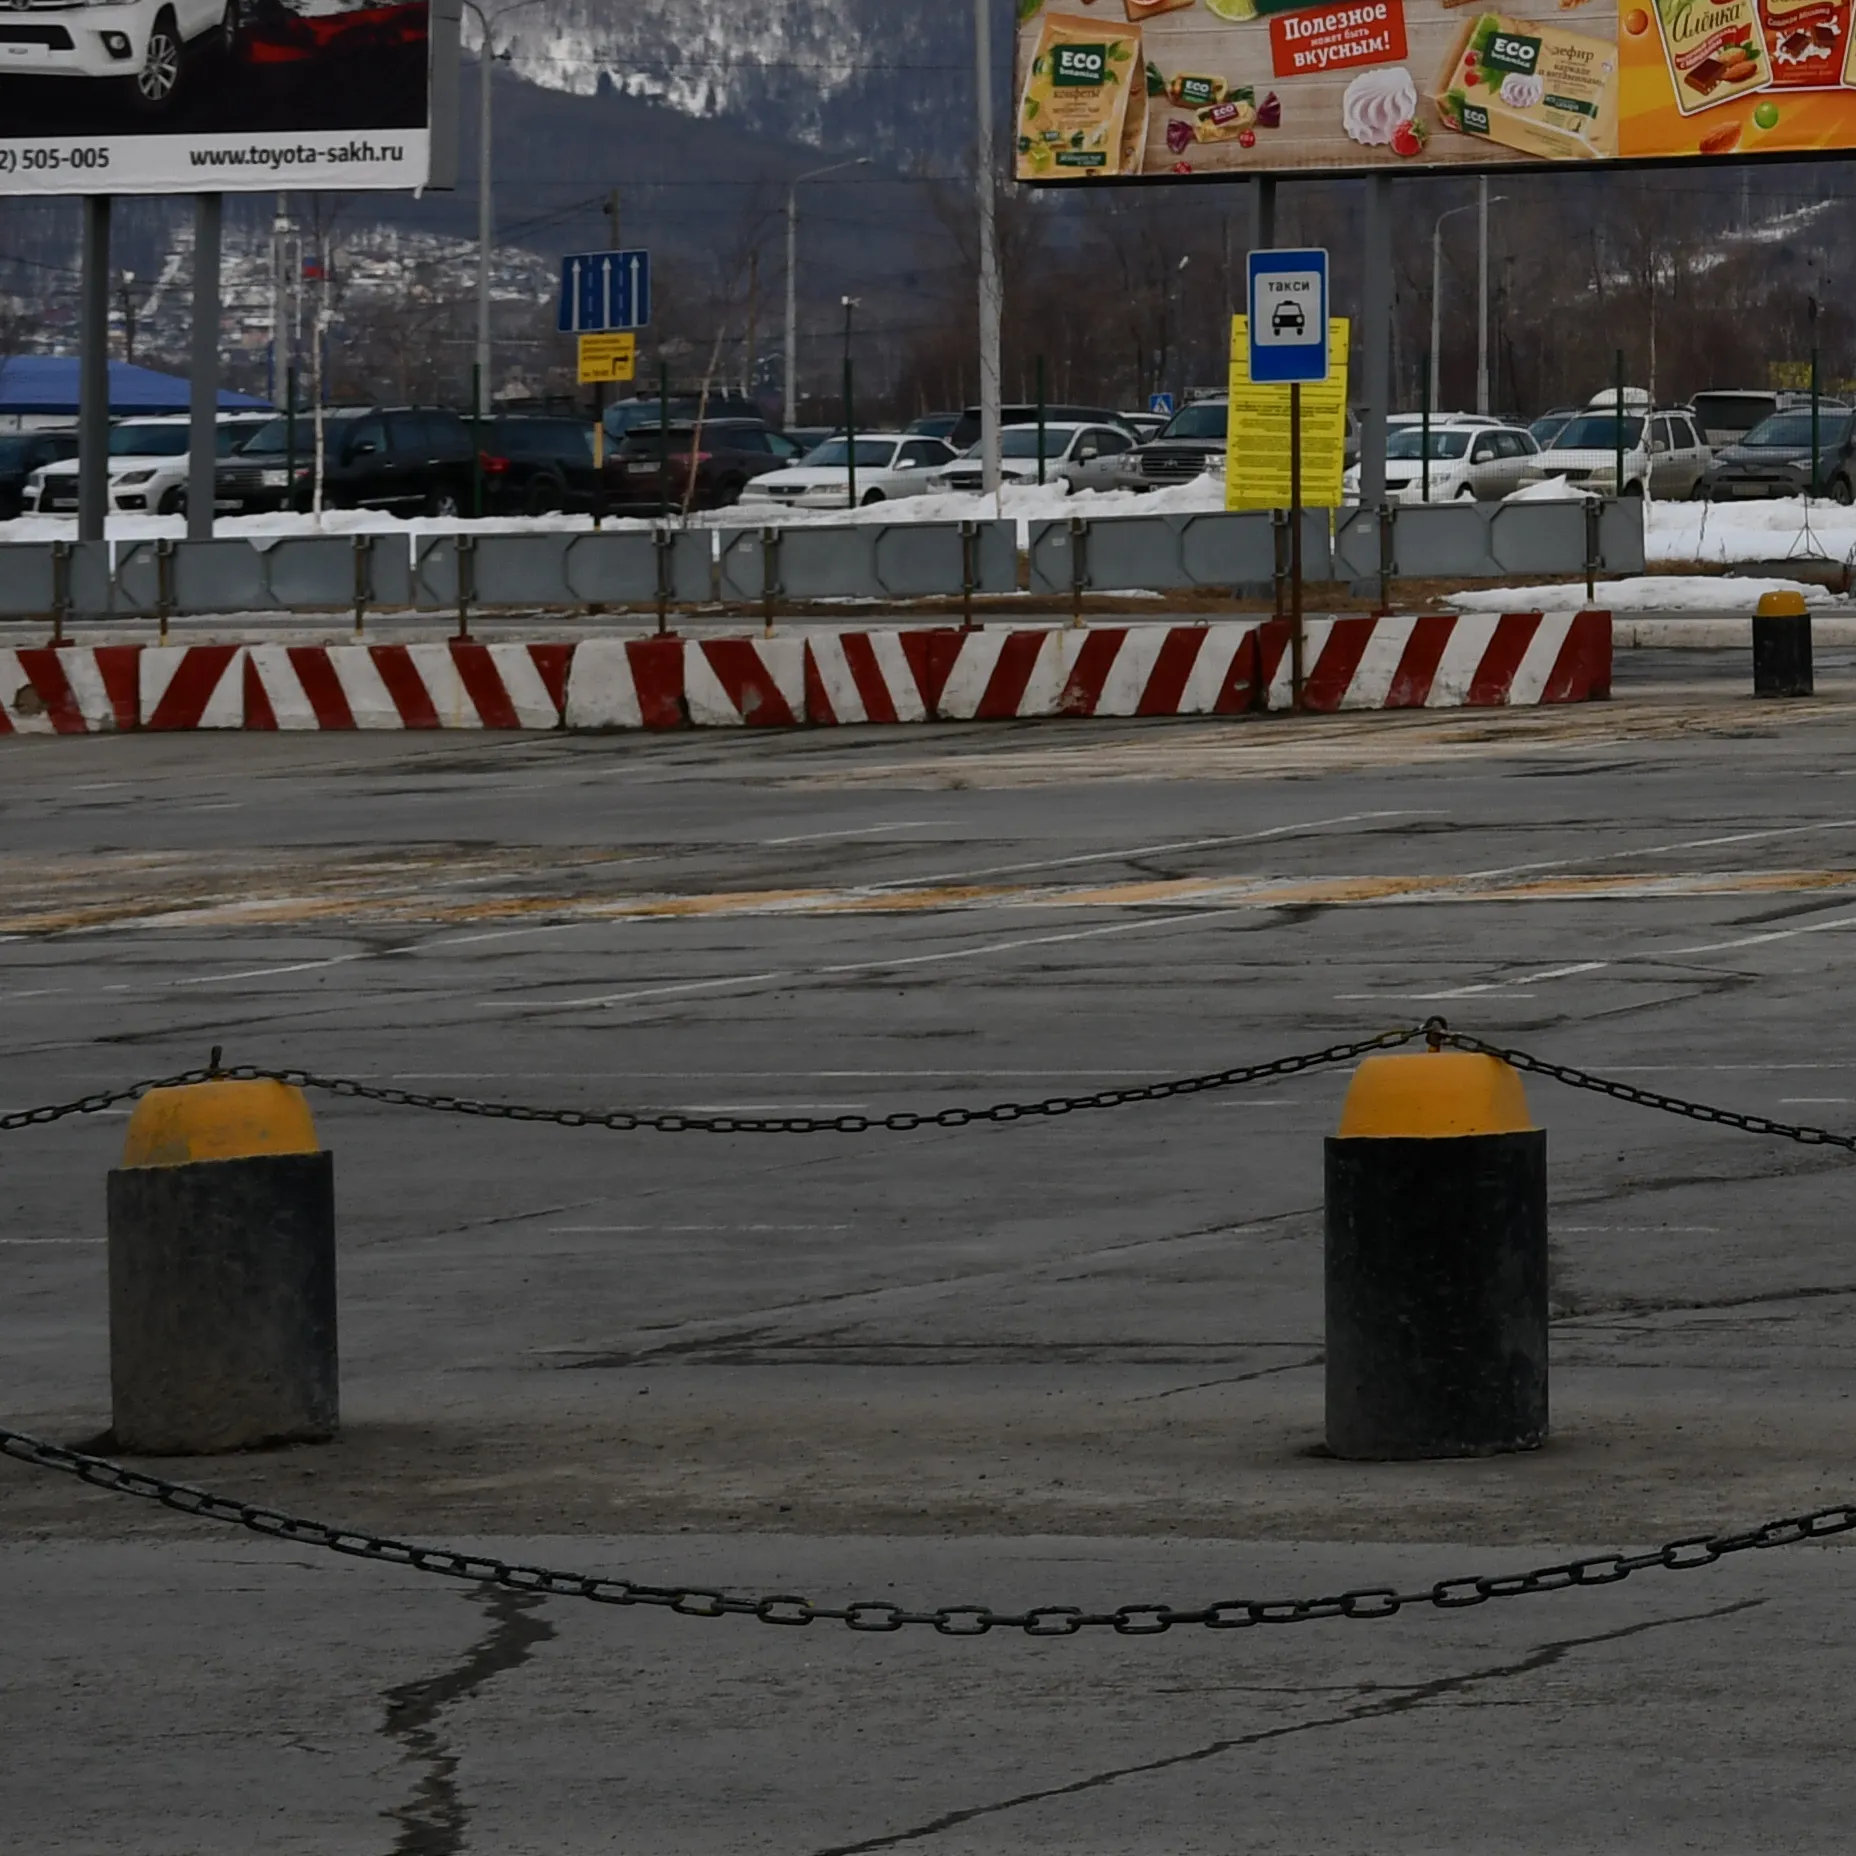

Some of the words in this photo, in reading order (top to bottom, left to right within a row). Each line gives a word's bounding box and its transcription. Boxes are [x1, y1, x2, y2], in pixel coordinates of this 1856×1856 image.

[1283, 2, 1387, 41] Полезное
[1672, 3, 1741, 43] Алёнка
[1344, 26, 1370, 40] быть
[1293, 30, 1391, 68] вкусным!
[1494, 38, 1534, 60] ECO
[1551, 45, 1594, 63] зефир
[1061, 51, 1101, 70] ECO
[1186, 80, 1209, 92] ECO
[1213, 105, 1233, 116] ECO
[1463, 109, 1486, 125] ECO
[22, 148, 109, 169] 505-005
[190, 142, 404, 170] www.toyota-sakh.ru
